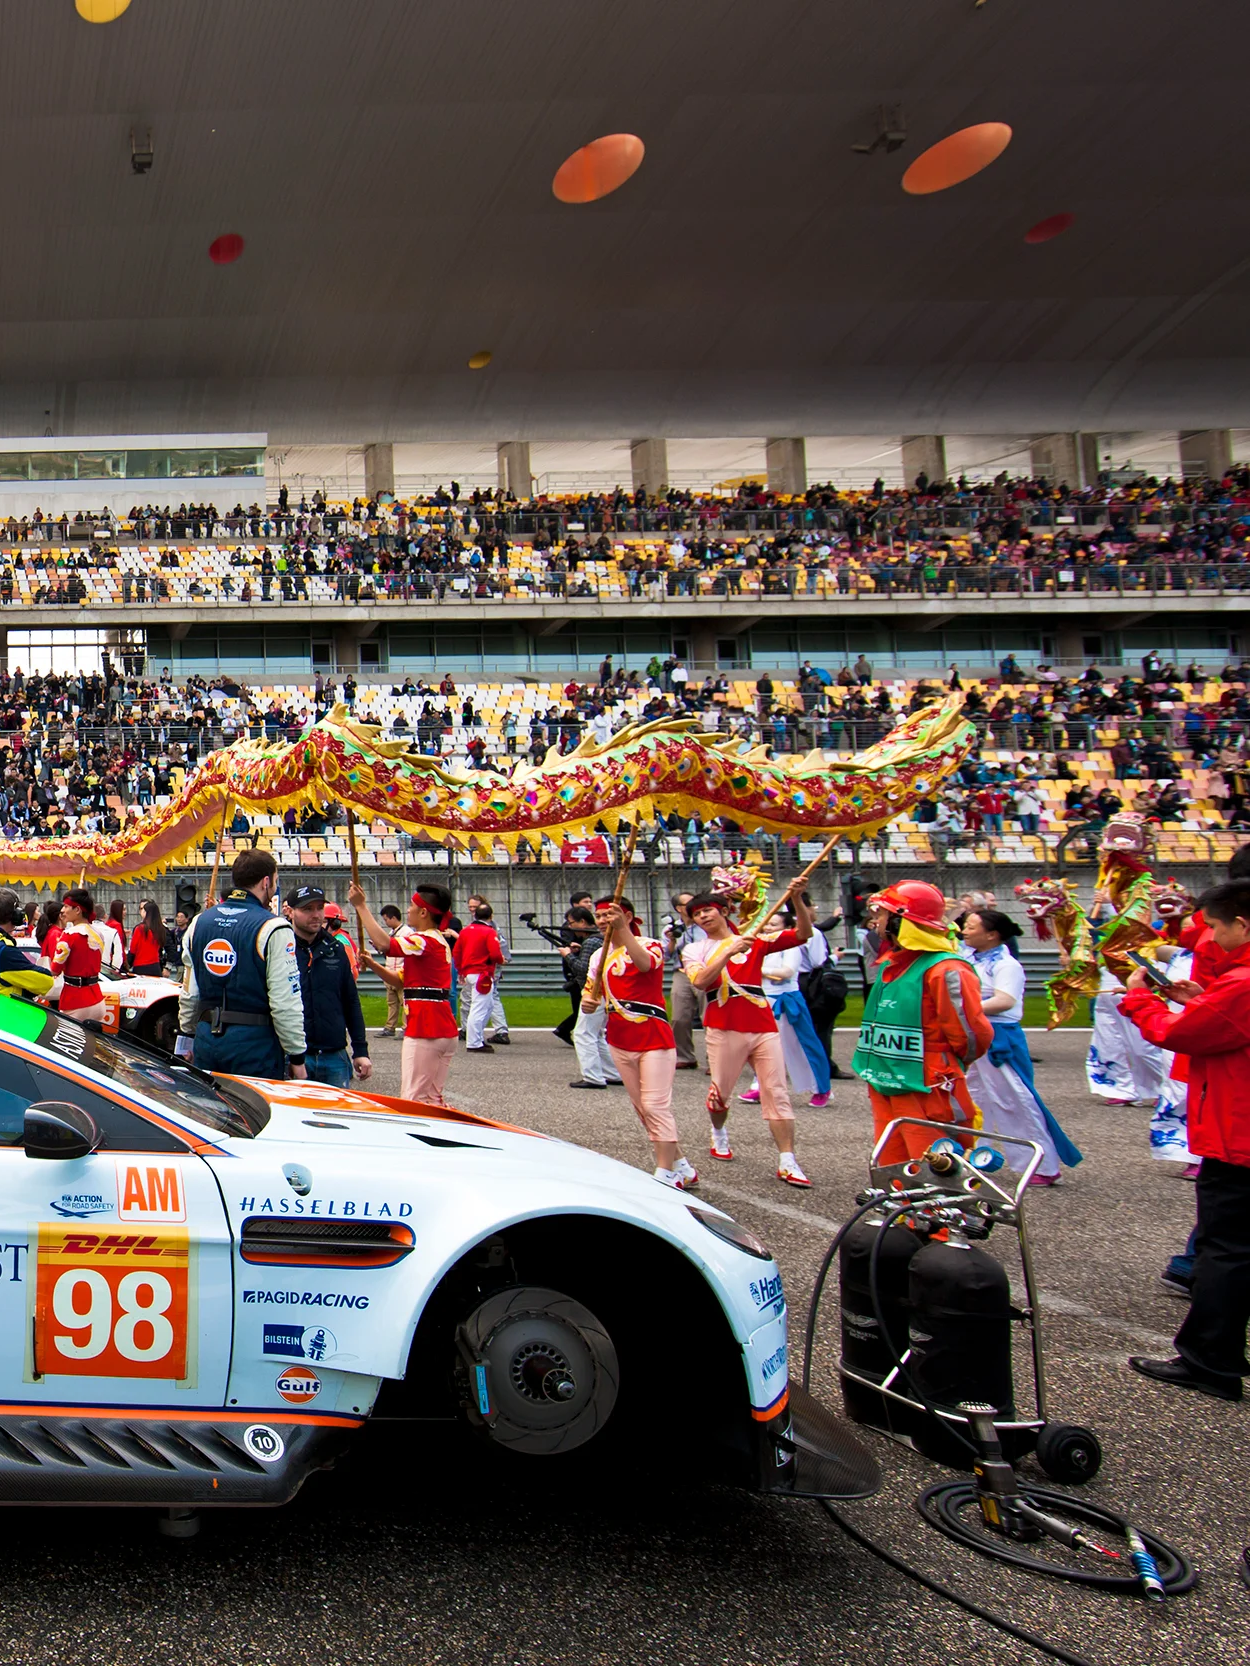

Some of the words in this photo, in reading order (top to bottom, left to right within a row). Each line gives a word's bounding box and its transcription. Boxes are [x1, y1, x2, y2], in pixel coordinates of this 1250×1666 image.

[204, 951, 235, 965] Gulf
[128, 988, 147, 999] AM
[122, 1166, 180, 1212] AM
[239, 1197, 413, 1217] HASSELBLAD
[61, 1234, 163, 1256] DHL
[52, 1268, 174, 1363] 98
[264, 1335, 300, 1346] BILSTEIN
[277, 1379, 320, 1392] Gulf
[254, 1436, 274, 1450] 10
